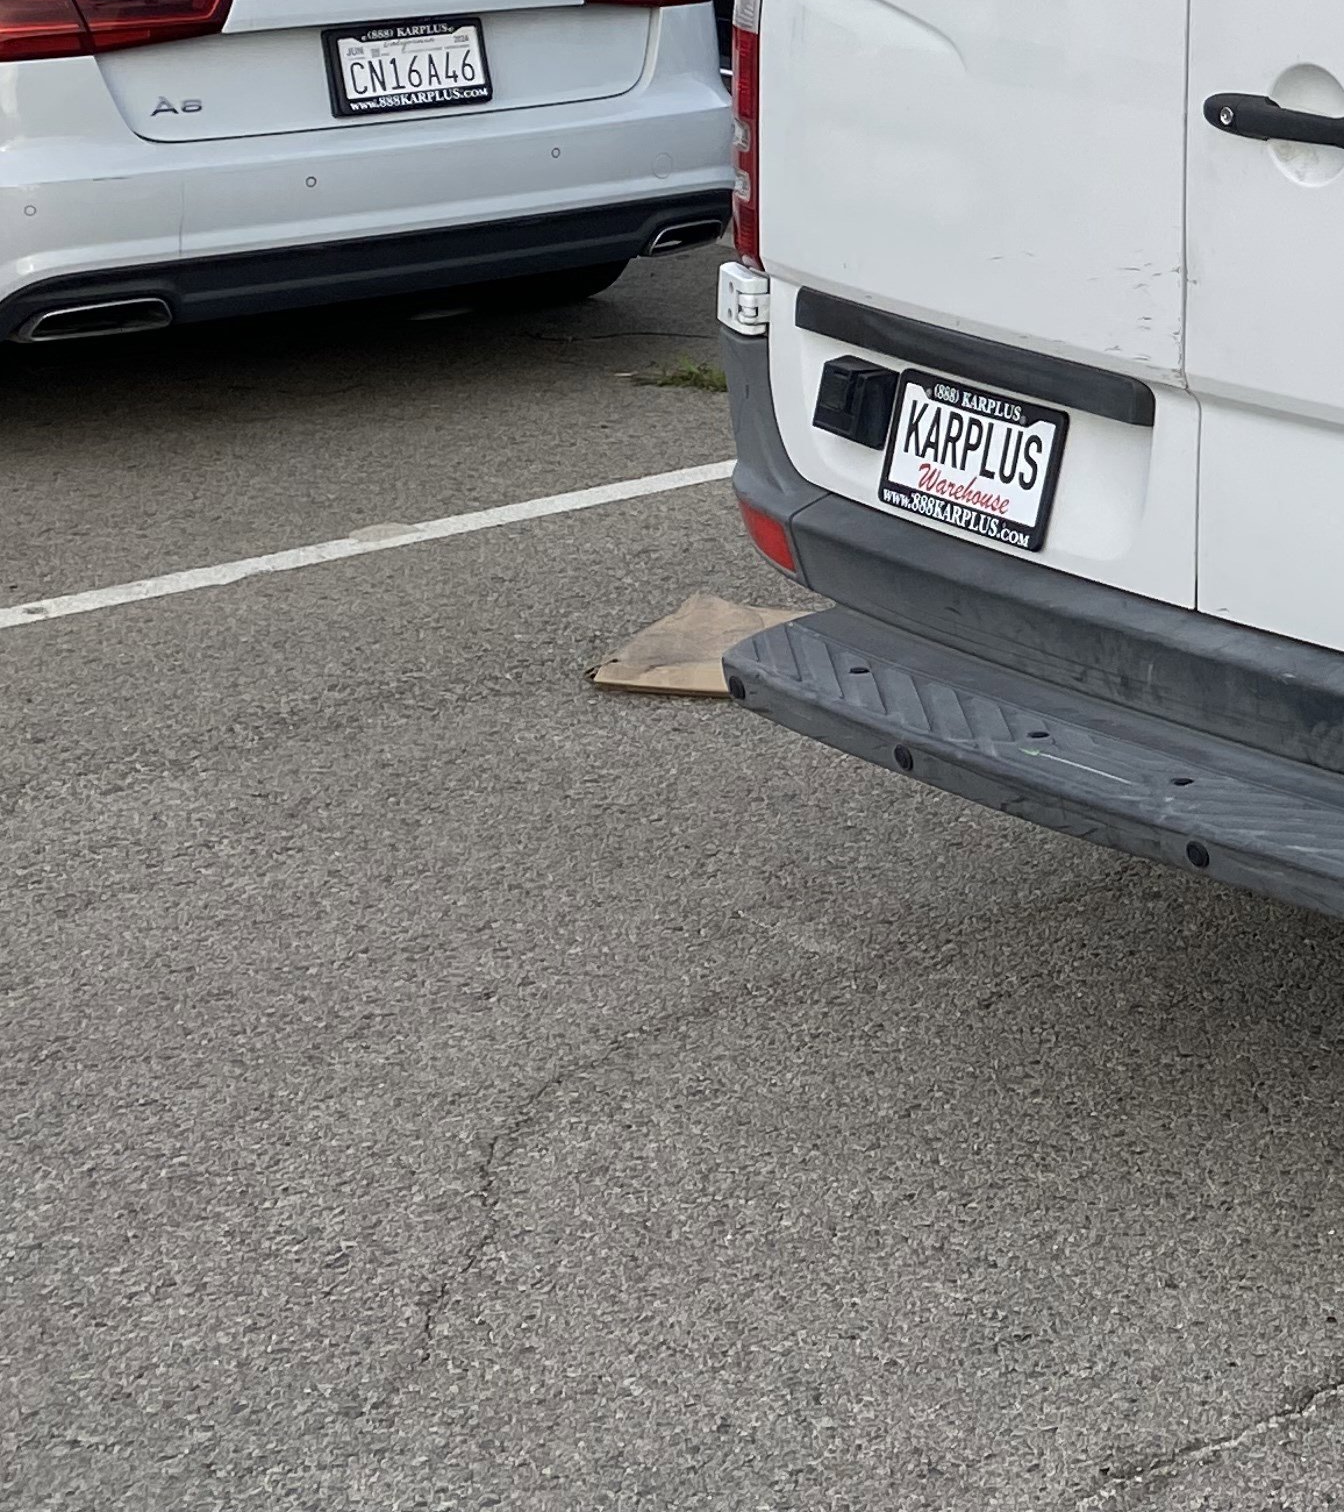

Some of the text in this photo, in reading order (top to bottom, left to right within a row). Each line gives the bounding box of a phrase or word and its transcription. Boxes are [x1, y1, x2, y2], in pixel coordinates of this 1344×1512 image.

[396, 23, 449, 37] KARPLUS
[349, 49, 476, 95] CN16A46
[933, 383, 1023, 422] (888) KARPLUS
[903, 399, 1043, 491] KARPLUS
[918, 462, 1011, 515] Warehouse
[882, 488, 1030, 548] www.888KARPLUS.COM
